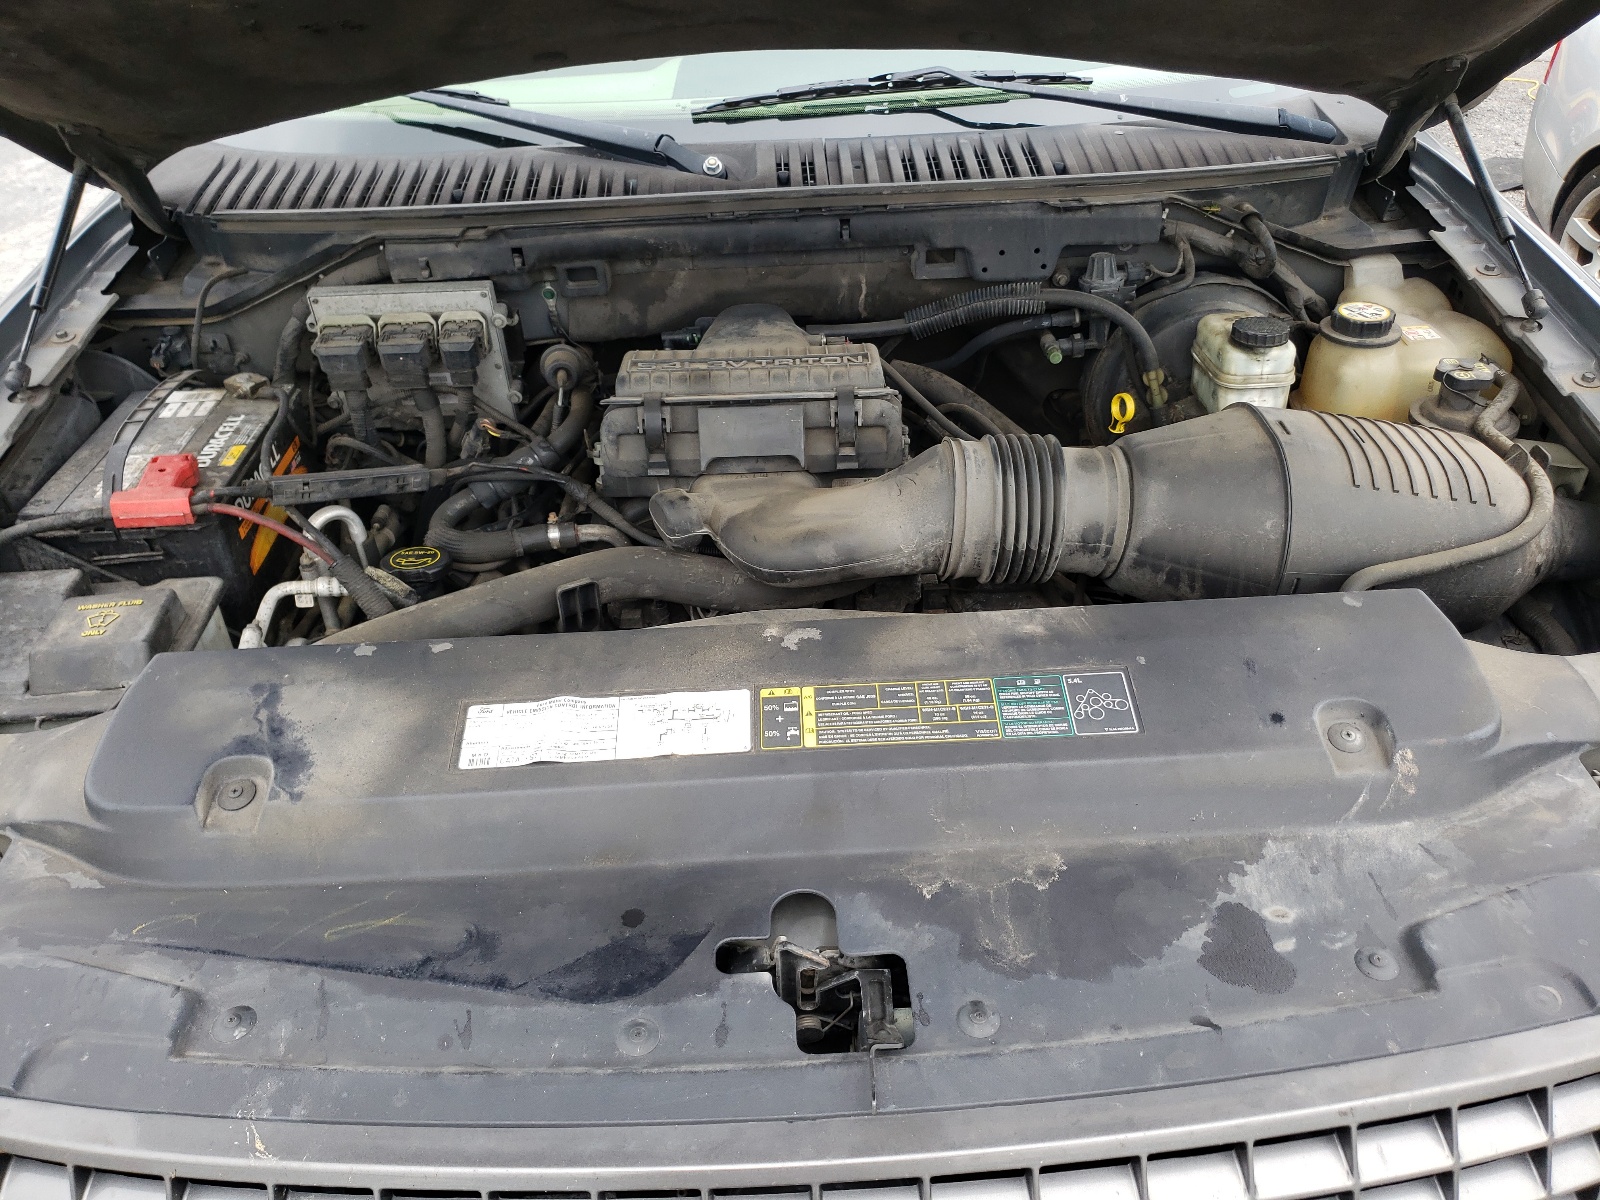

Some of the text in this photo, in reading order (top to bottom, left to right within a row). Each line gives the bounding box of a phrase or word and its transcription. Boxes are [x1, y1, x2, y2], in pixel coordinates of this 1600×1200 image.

[707, 360, 748, 369] 3V
[755, 355, 863, 367] TRITON
[197, 414, 245, 468] DURACELL
[77, 599, 143, 610] WASHER FLUID
[81, 629, 107, 637] ONLY
